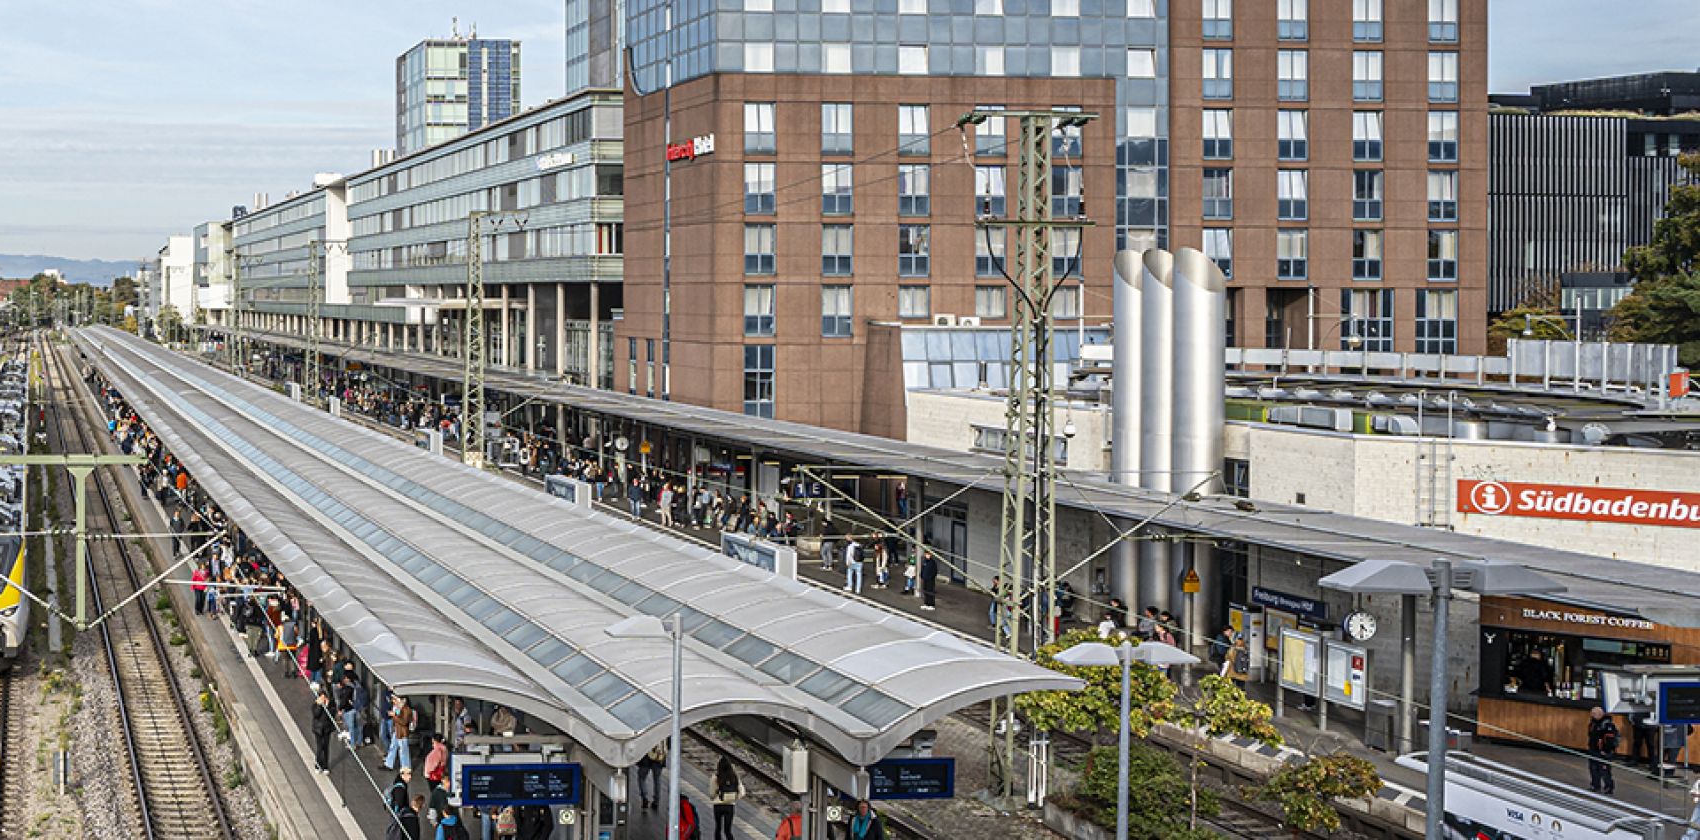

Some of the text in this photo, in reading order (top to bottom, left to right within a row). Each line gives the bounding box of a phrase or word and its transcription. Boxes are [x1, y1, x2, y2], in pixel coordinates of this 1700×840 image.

[812, 483, 821, 495] E
[1523, 608, 1654, 630] BLACK FOREST COFFEE
[1506, 808, 1524, 821] VISA
